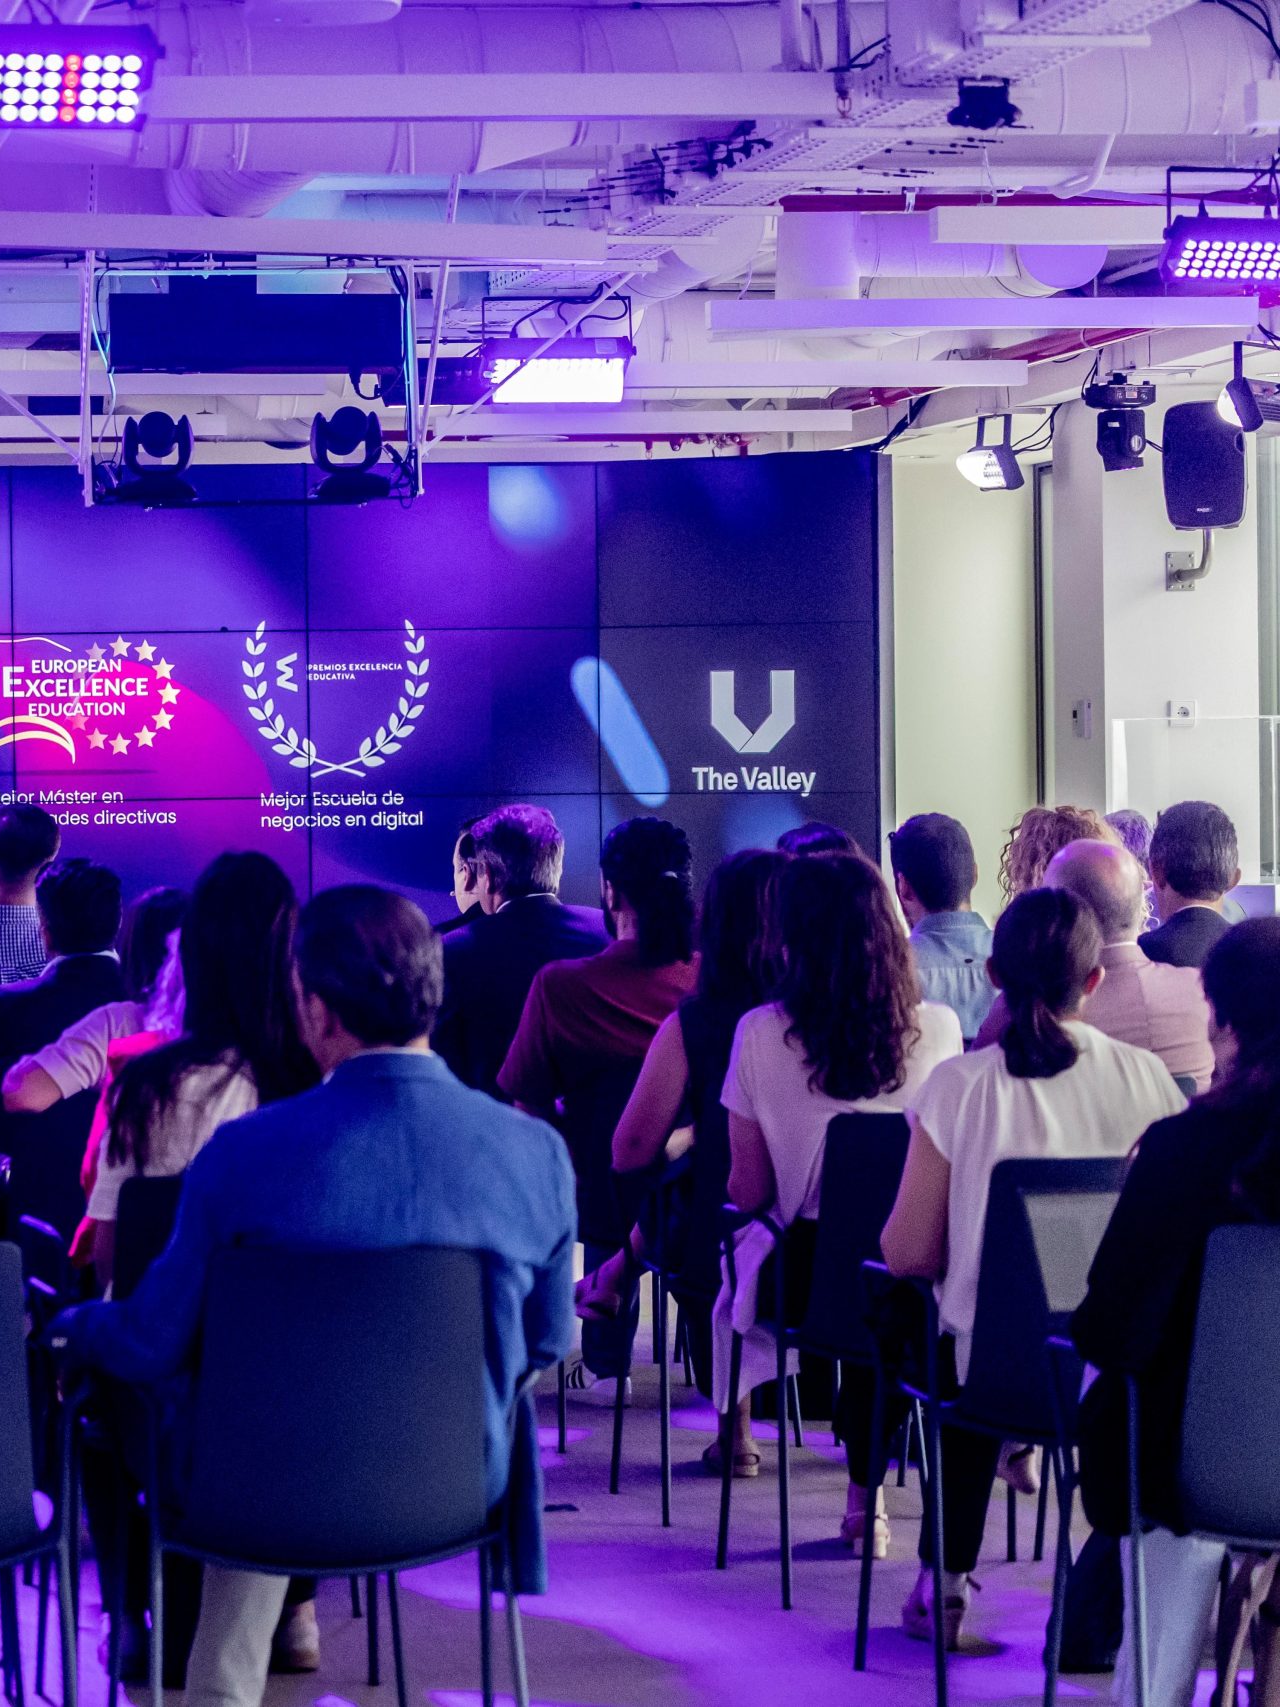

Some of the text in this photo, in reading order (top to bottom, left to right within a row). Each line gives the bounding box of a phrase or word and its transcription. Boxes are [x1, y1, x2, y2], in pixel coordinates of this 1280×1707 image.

[31, 658, 122, 674] EUROPEAN
[306, 662, 403, 671] PREMIOS EXCELENCIA
[2, 665, 149, 698] EXCELLENCE
[306, 672, 356, 681] EDUCATIVA
[28, 702, 126, 717] EDUCATION
[691, 765, 817, 797] The Valley
[39, 789, 96, 804] Máster
[101, 791, 124, 804] en
[260, 790, 404, 811] Mejor Escuela de
[93, 809, 177, 825] directivas
[260, 810, 424, 832] negocios en digital
